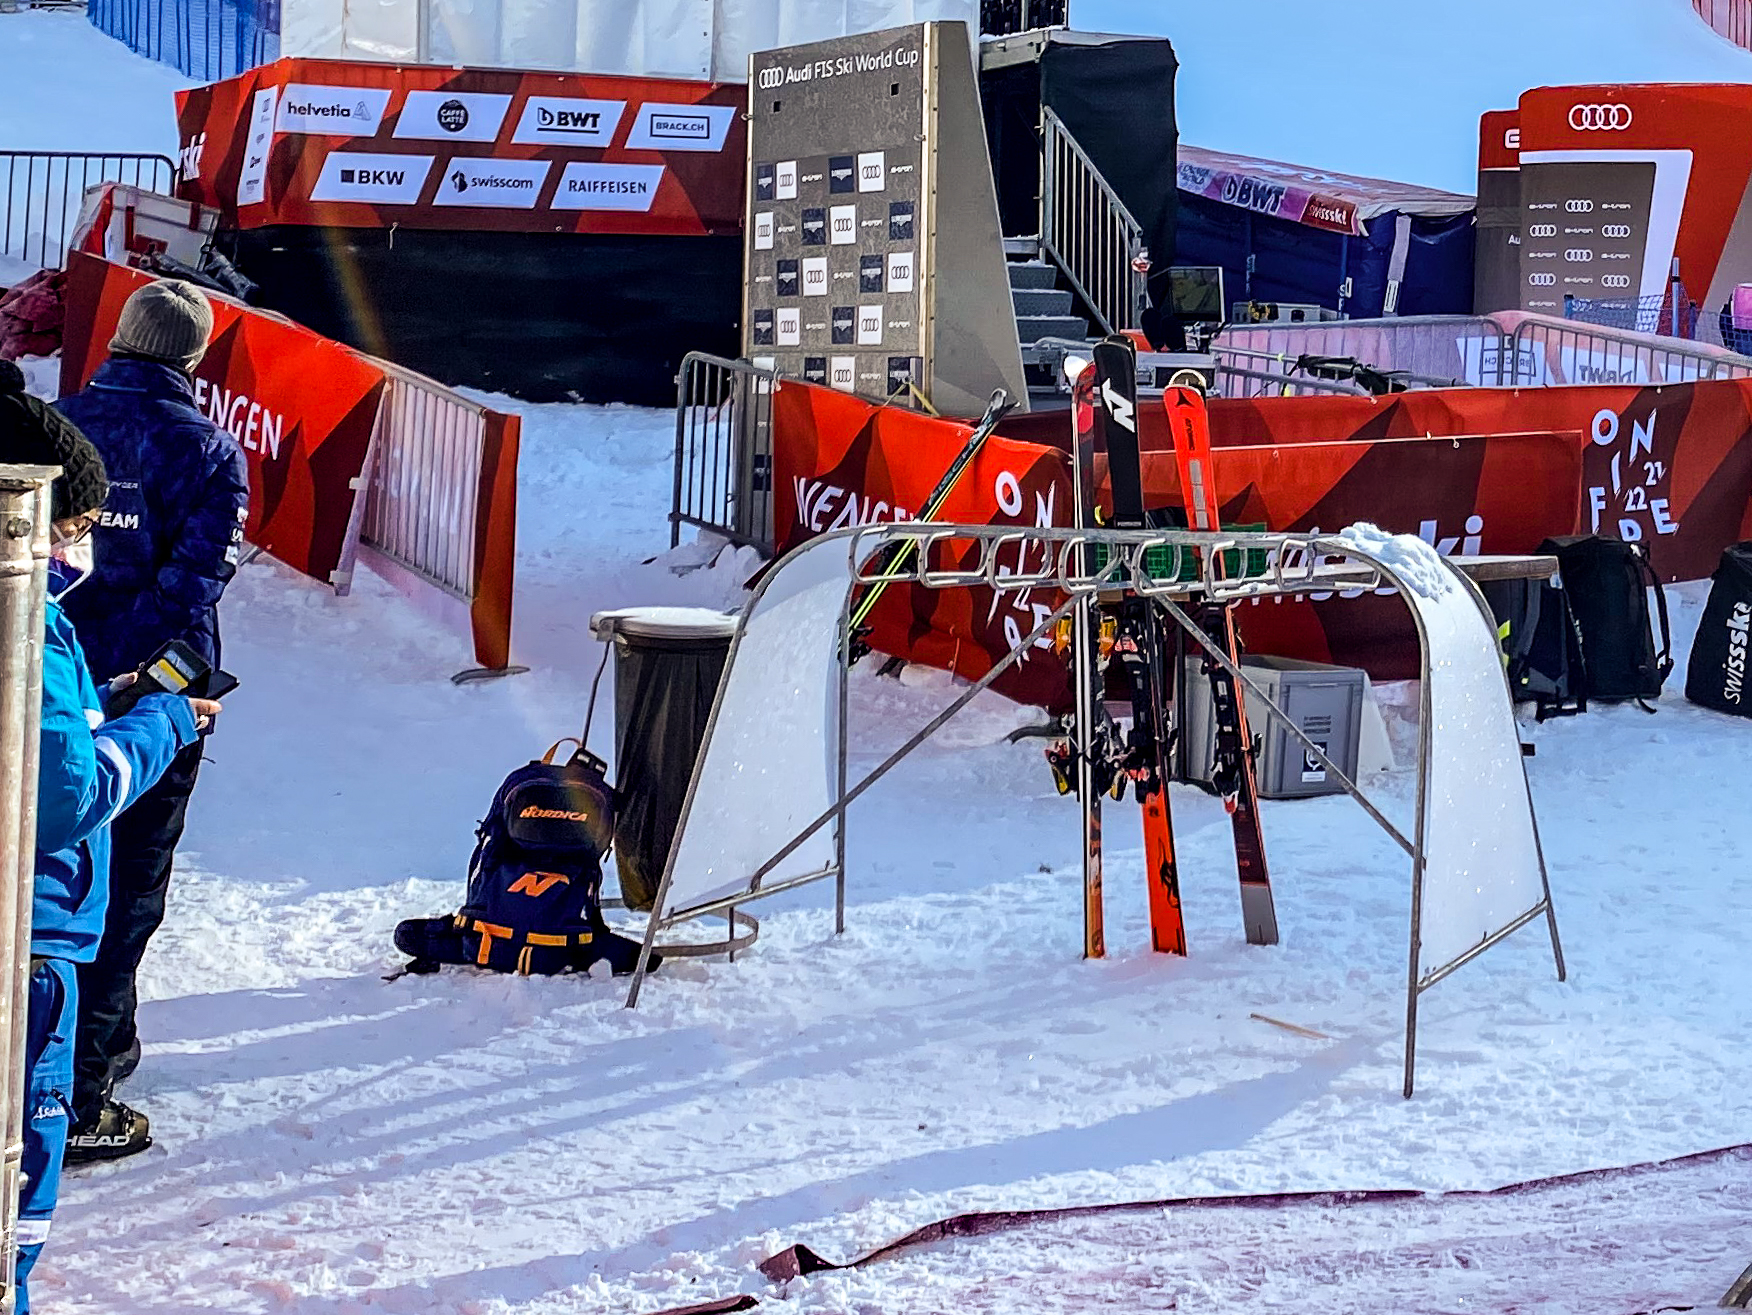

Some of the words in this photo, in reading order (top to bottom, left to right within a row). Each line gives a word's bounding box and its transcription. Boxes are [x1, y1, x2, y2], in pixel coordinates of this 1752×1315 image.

[785, 63, 811, 84] Audi
[814, 59, 835, 79] FIS
[835, 57, 853, 76] Ski
[855, 50, 892, 73] World
[895, 47, 919, 67] Cup
[287, 101, 351, 117] helvetia
[441, 116, 465, 124] LATTE
[557, 111, 600, 128] BWT
[656, 121, 705, 131] BRACK.CH
[358, 169, 405, 185] BKW
[471, 174, 533, 189] swisscom
[568, 179, 647, 194] RAIFFEISEN
[1237, 178, 1286, 213] BWT
[195, 378, 284, 461] ENGEN
[793, 476, 919, 532] WENG
[100, 511, 139, 529] EAM
[66, 1135, 130, 1147] HEAD
